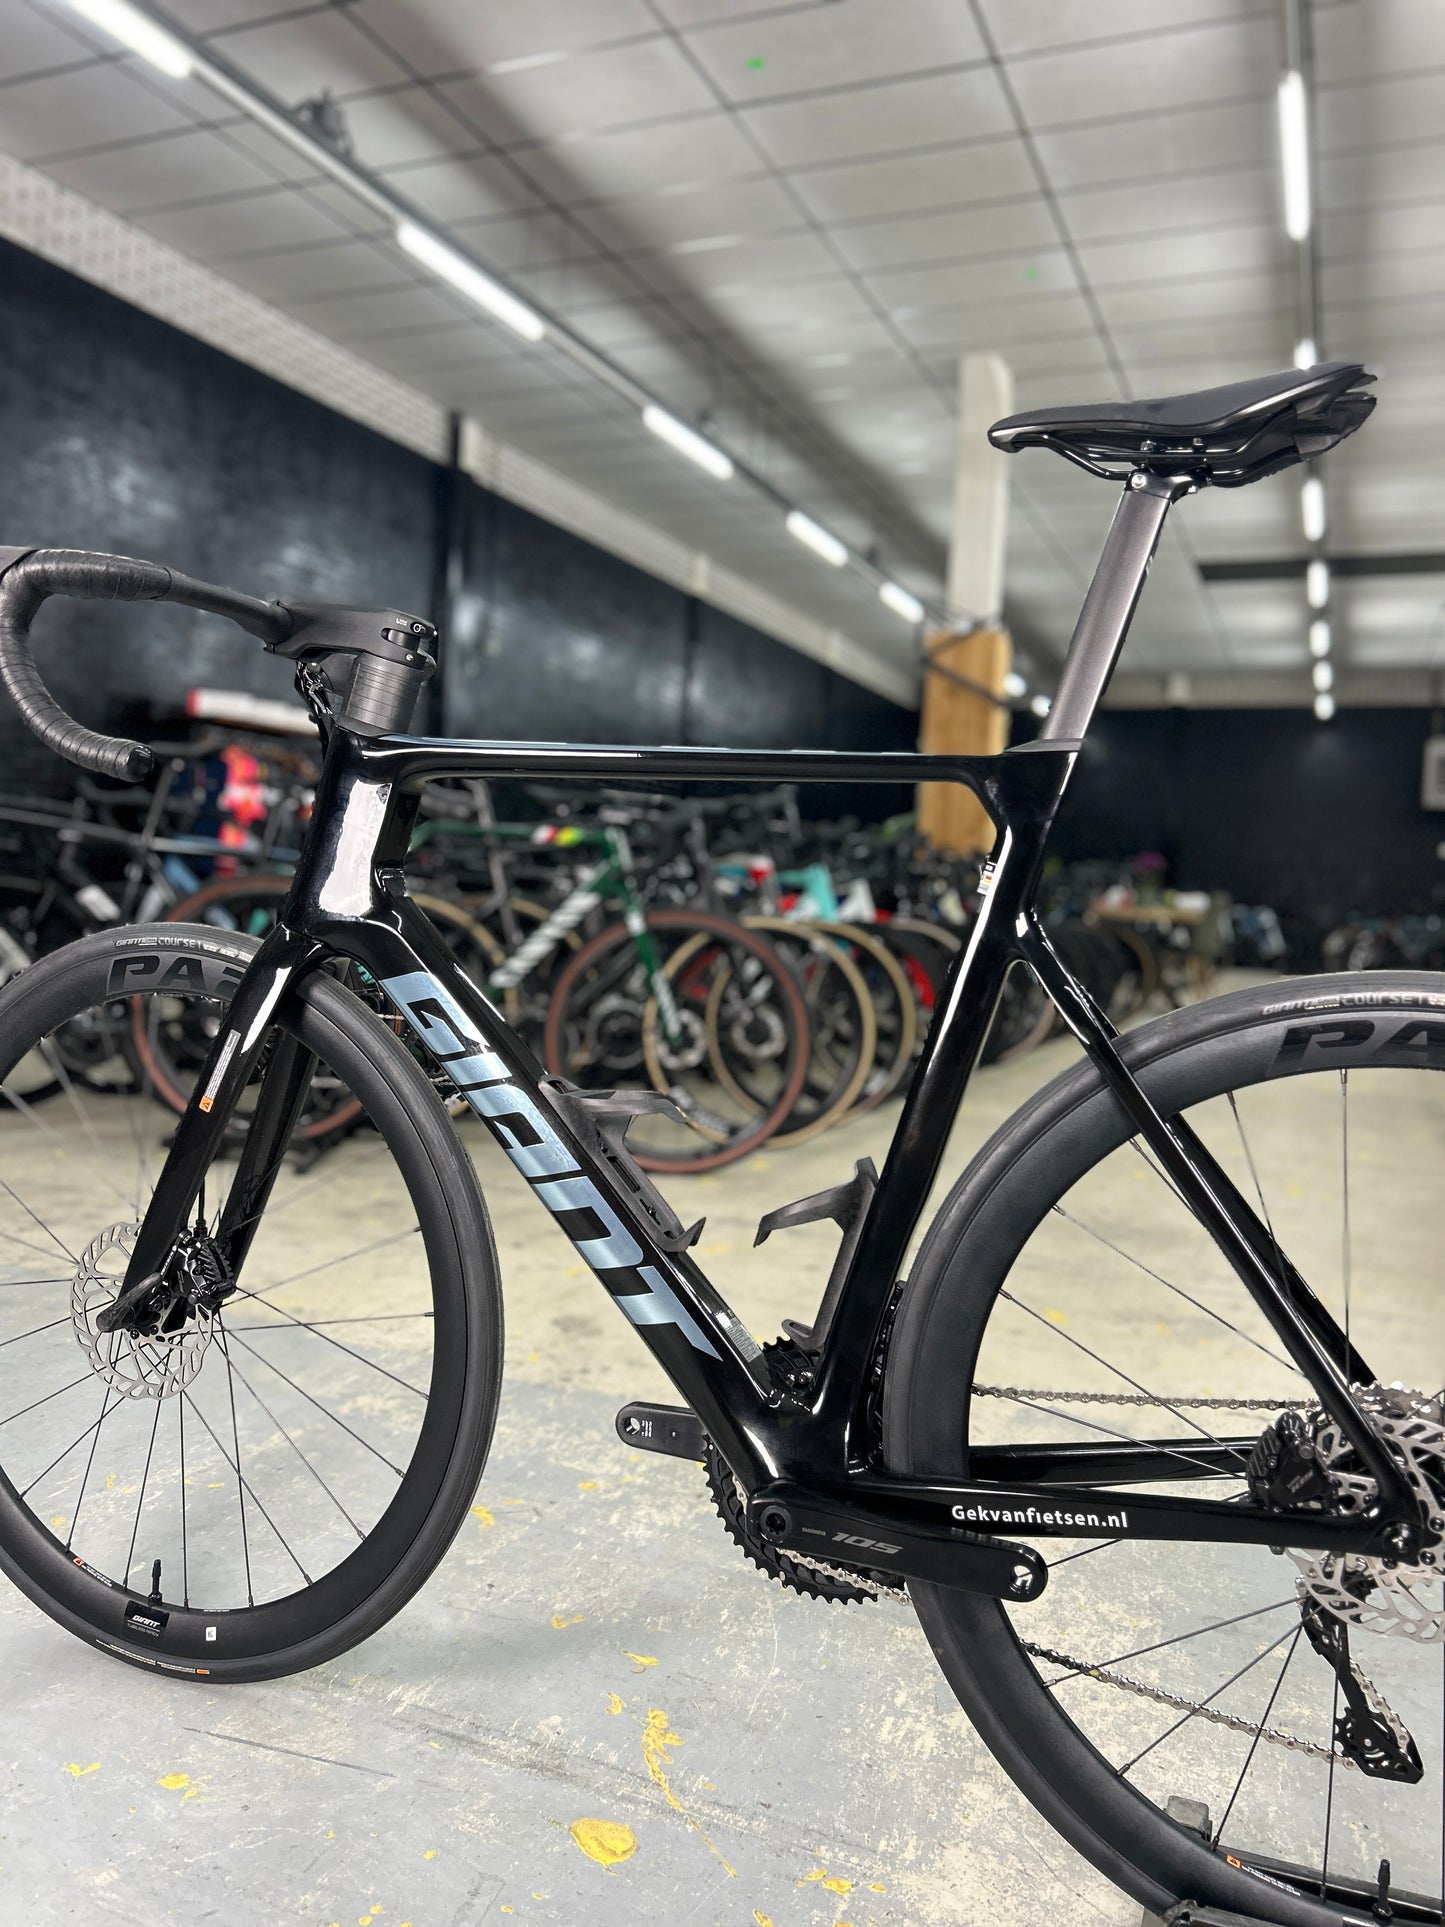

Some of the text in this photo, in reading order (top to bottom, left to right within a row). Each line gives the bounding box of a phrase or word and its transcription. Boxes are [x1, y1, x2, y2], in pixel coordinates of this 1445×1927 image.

[158, 936, 196, 949] COURSE
[1341, 991, 1413, 1007] COURSE
[381, 971, 724, 1362] GIANT
[951, 1504, 1129, 1529] Gekvanfietsen.nl
[831, 1531, 904, 1555] 105
[131, 1614, 161, 1629] GIANT
